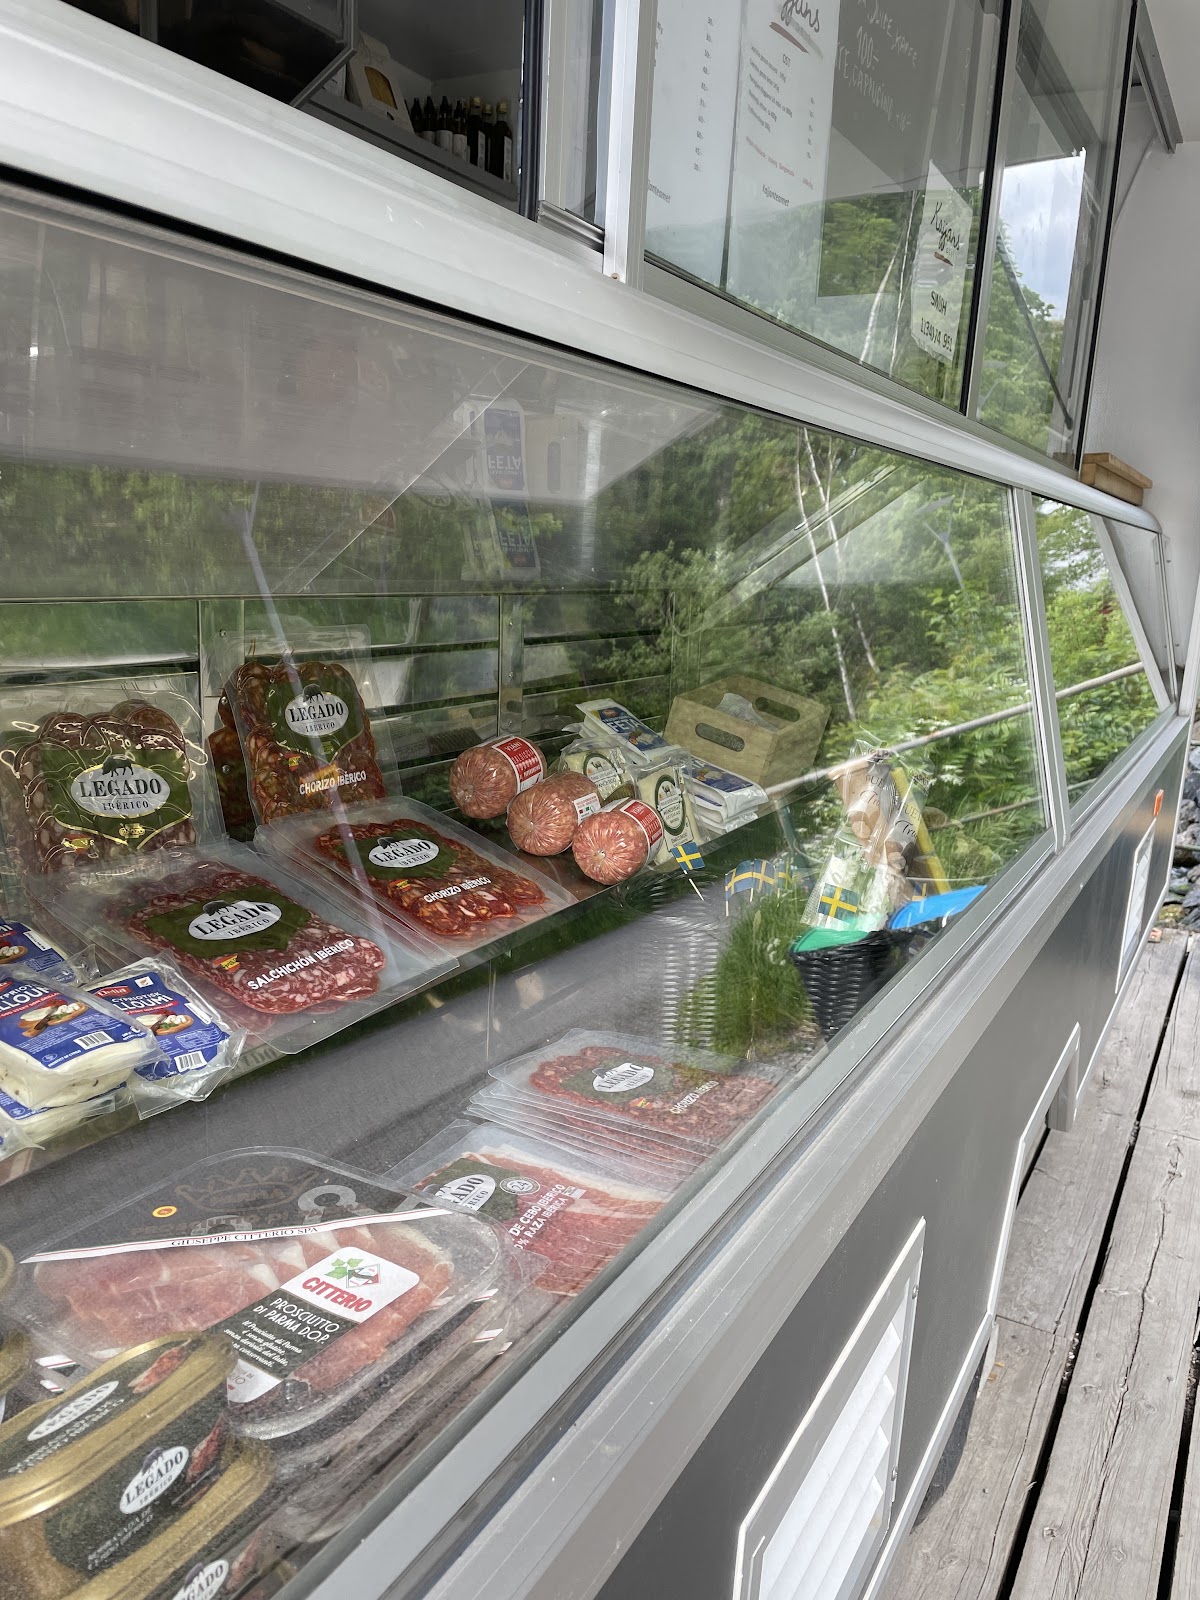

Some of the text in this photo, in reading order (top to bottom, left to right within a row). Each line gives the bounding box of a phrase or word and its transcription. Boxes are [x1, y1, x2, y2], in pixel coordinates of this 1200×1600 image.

[288, 701, 344, 723] LEGADO
[607, 718, 641, 733] FETA
[79, 778, 163, 798] LEGADO
[299, 769, 367, 796] CHORIZO IBÉRICO
[373, 840, 432, 863] LEGADO
[423, 876, 492, 903] CHORIZO IBÉRICO
[193, 904, 271, 936] LEGADO
[228, 918, 271, 936] IBÉRICO
[247, 957, 317, 991] SALCHICHÓN
[314, 938, 356, 960] IBÉRICO
[113, 994, 174, 1011] LLOUMI
[511, 1180, 530, 1191] 24
[508, 1183, 566, 1237] DE CEBO IBÉRICO
[171, 1226, 319, 1247] GIUSEPPE CITTERIO SPA
[523, 1217, 547, 1239] RAZA
[301, 1276, 373, 1314] CITTERIO
[253, 1304, 265, 1316] DI
[260, 1307, 302, 1335] PARMA
[270, 1297, 341, 1333] PROSCIUTTO
[281, 1341, 303, 1354] Parma
[123, 1450, 185, 1504] LEGADO
